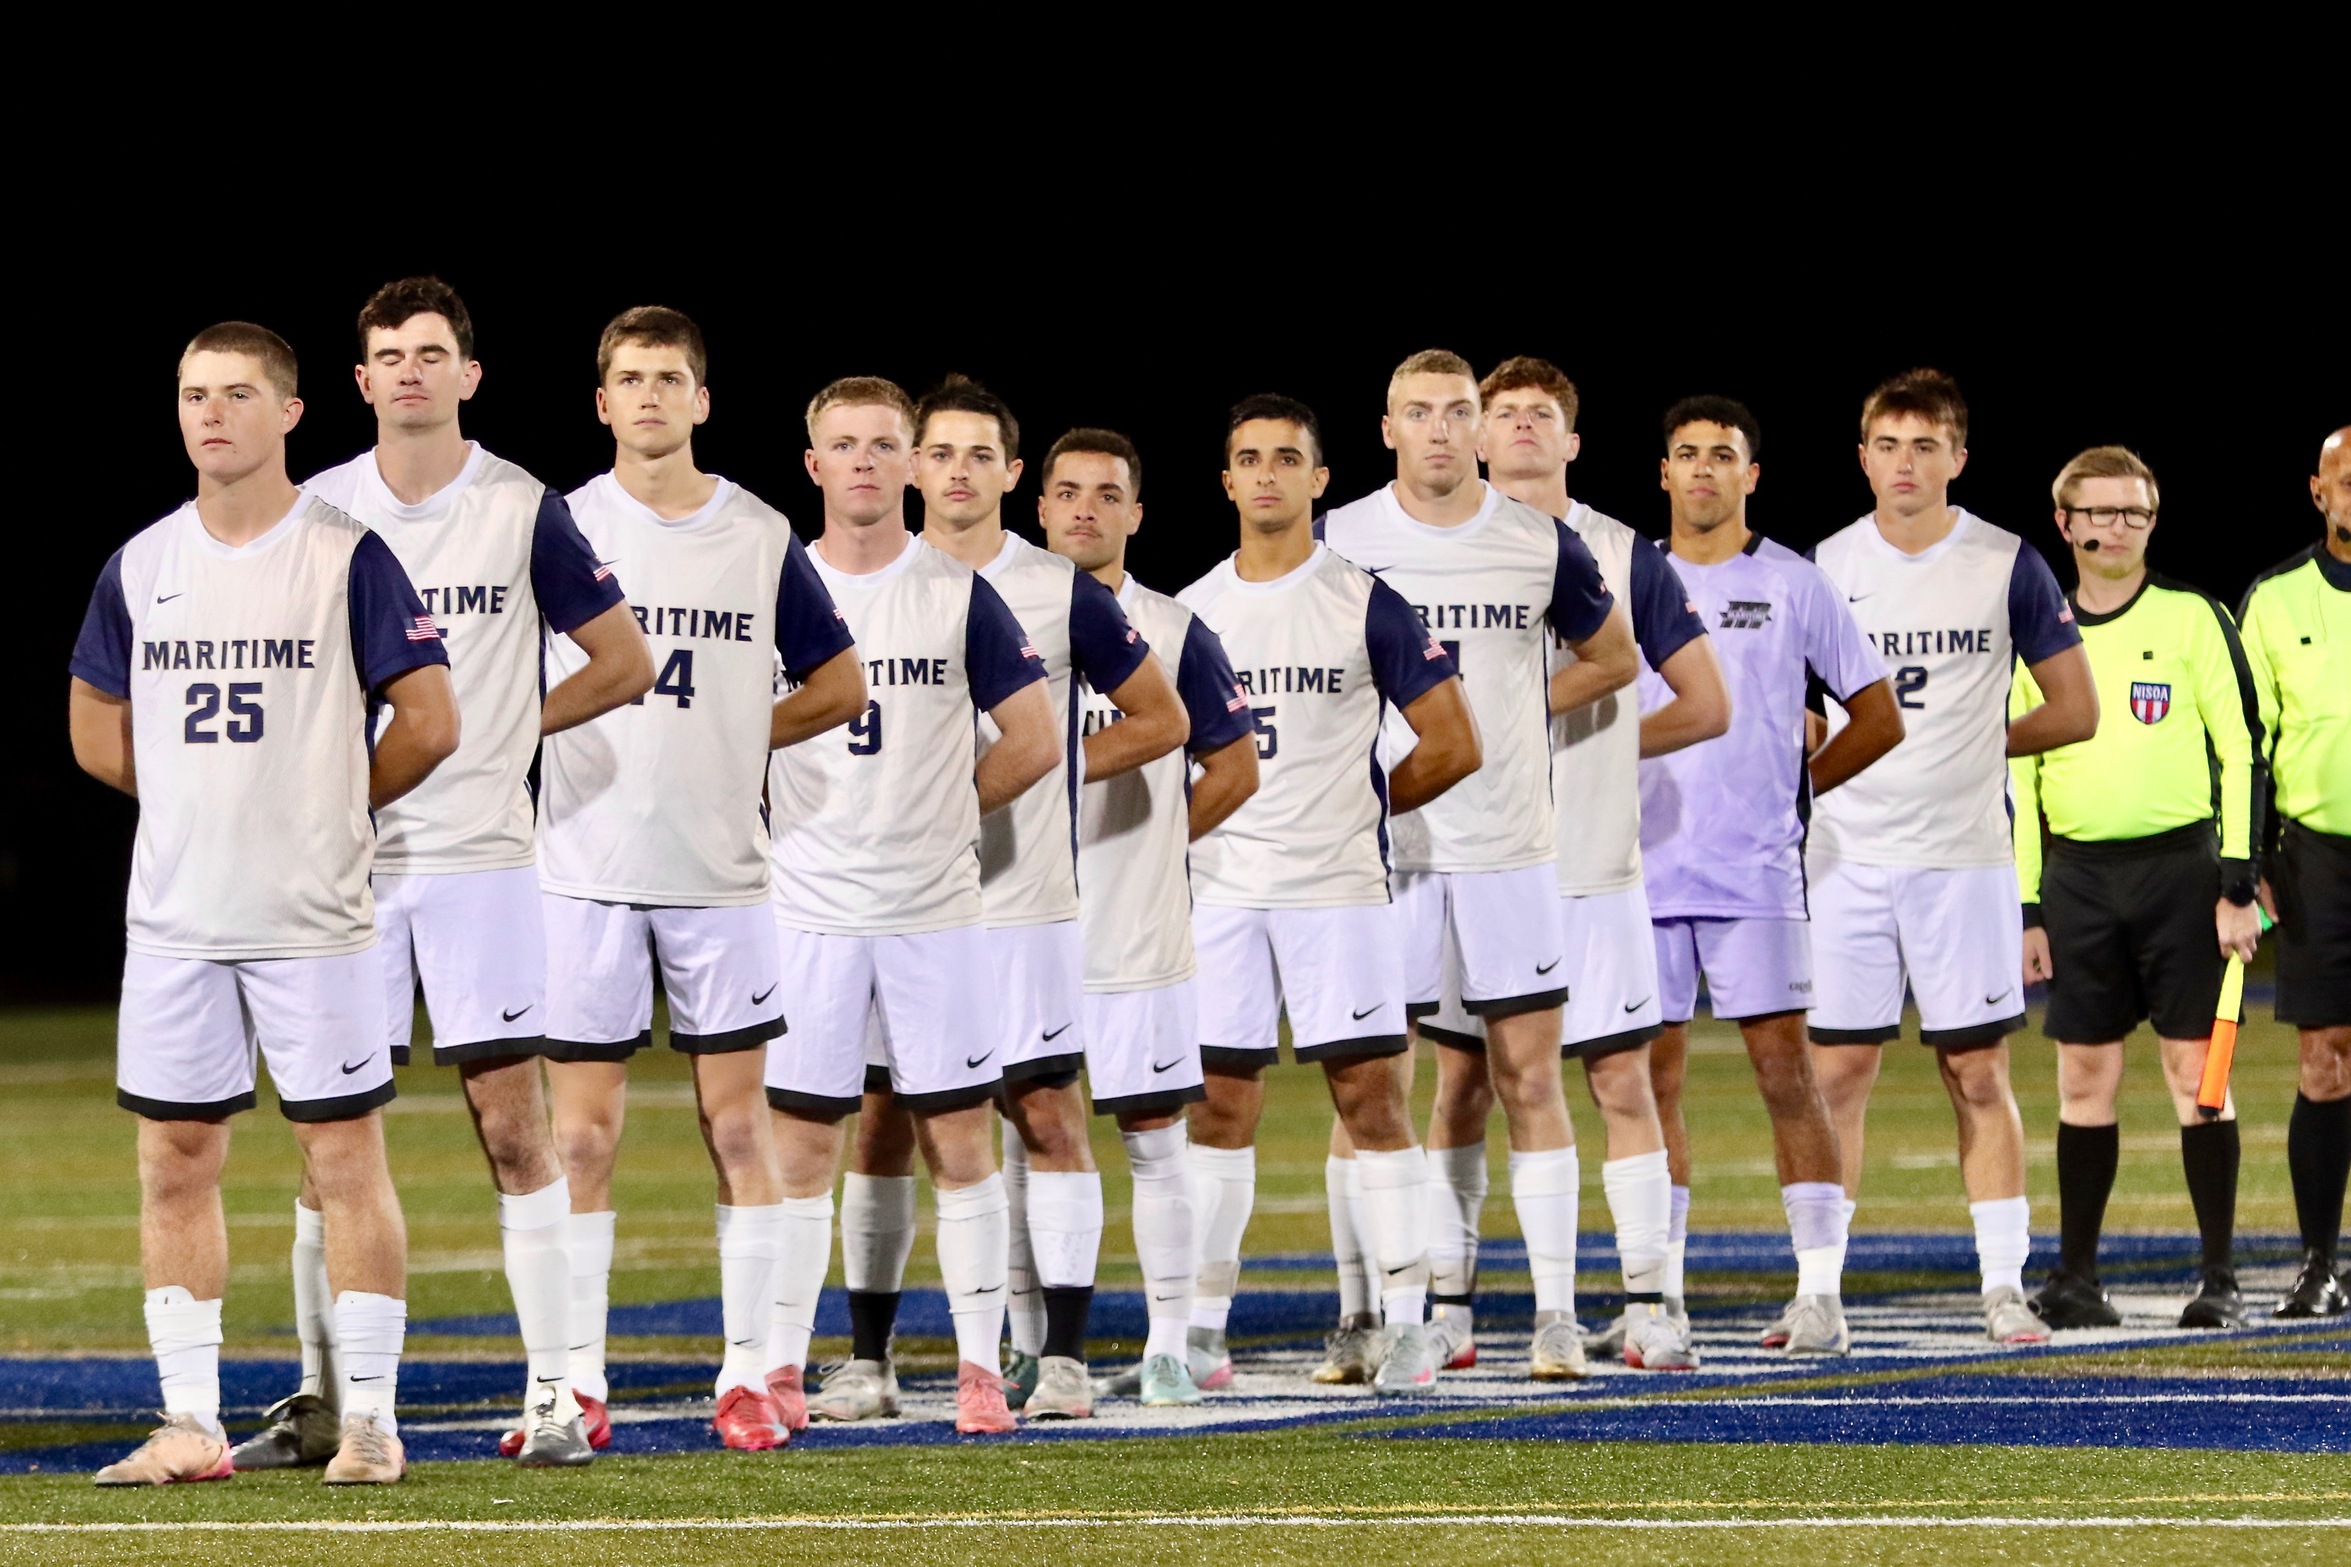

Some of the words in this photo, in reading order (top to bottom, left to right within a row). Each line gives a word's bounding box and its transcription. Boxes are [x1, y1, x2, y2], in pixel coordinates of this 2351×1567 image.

[421, 586, 508, 615] TIME
[629, 605, 755, 642] RITIME
[1413, 605, 1530, 630] RITIME
[142, 639, 315, 670] MARITIME
[862, 658, 948, 686] TIME
[1235, 667, 1345, 695] RITIME
[1895, 666, 1928, 709] 2
[2132, 683, 2169, 702] NISOA
[185, 682, 264, 744] 25
[848, 699, 882, 756] 9
